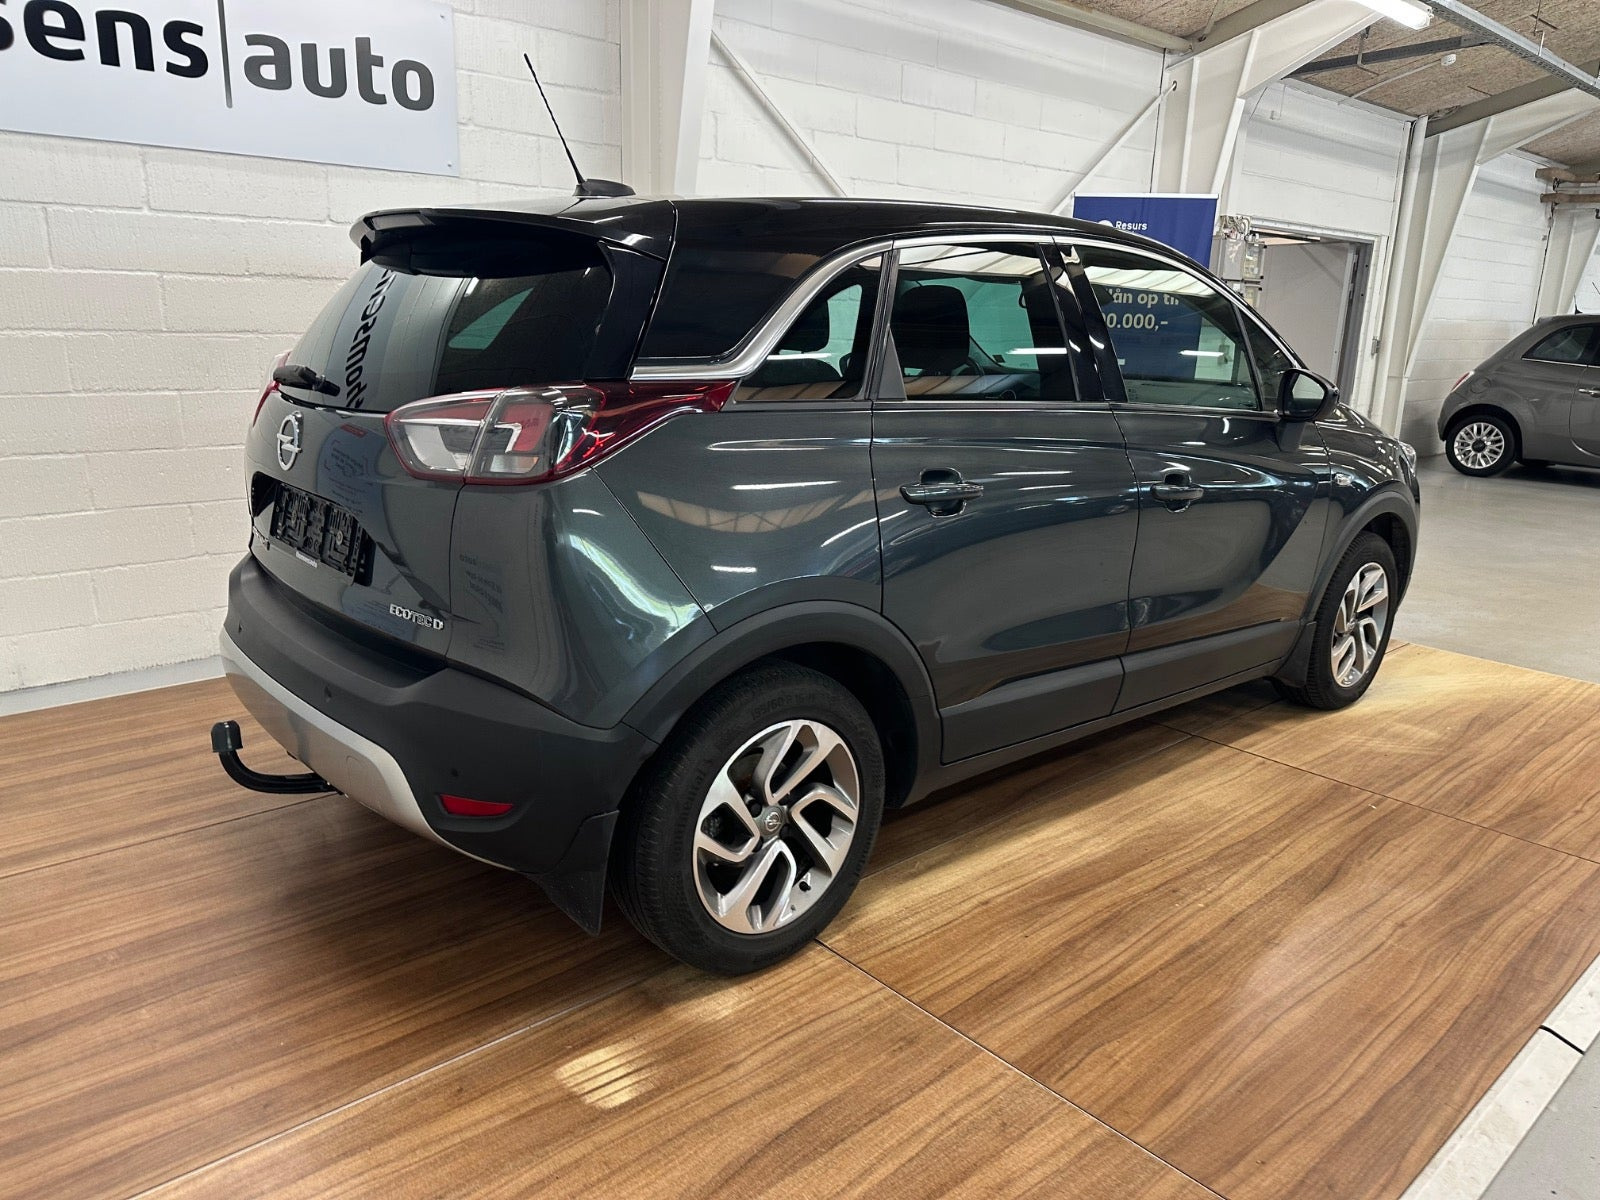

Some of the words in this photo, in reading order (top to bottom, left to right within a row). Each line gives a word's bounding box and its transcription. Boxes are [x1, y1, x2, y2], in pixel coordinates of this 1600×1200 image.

[0, 0, 209, 78] ens
[243, 33, 435, 112] auto
[1115, 220, 1148, 231] Resurs
[1137, 293, 1159, 308] op
[1102, 312, 1169, 332] 0.000,-
[390, 603, 433, 628] ECOTEC
